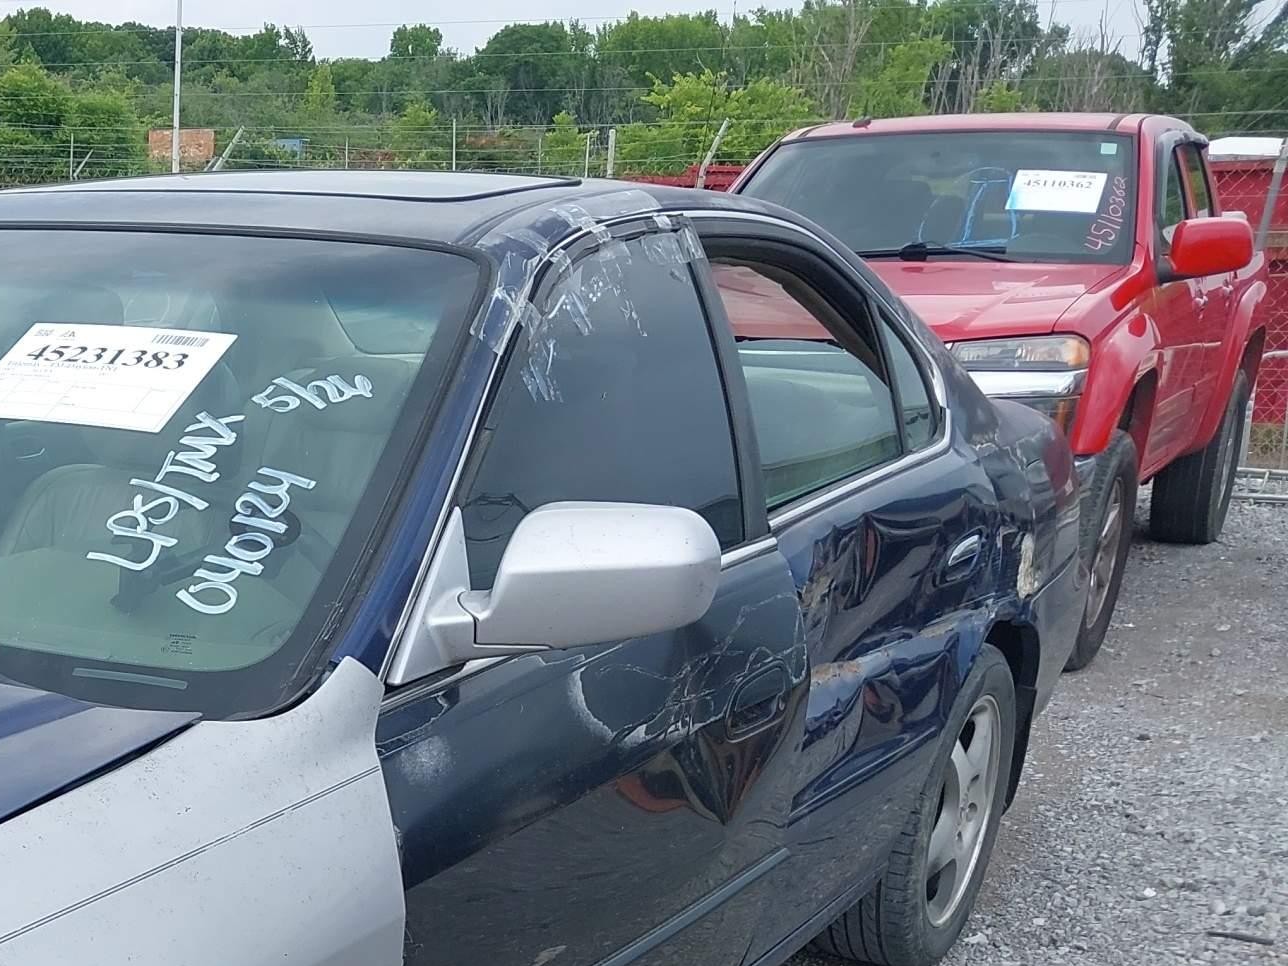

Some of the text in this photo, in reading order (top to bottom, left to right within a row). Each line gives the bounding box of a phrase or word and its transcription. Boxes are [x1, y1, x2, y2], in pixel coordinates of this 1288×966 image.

[1023, 179, 1093, 189] 45110362
[1084, 176, 1128, 250] 45110362
[26, 344, 190, 370] 45231383
[175, 466, 317, 614] 040124
